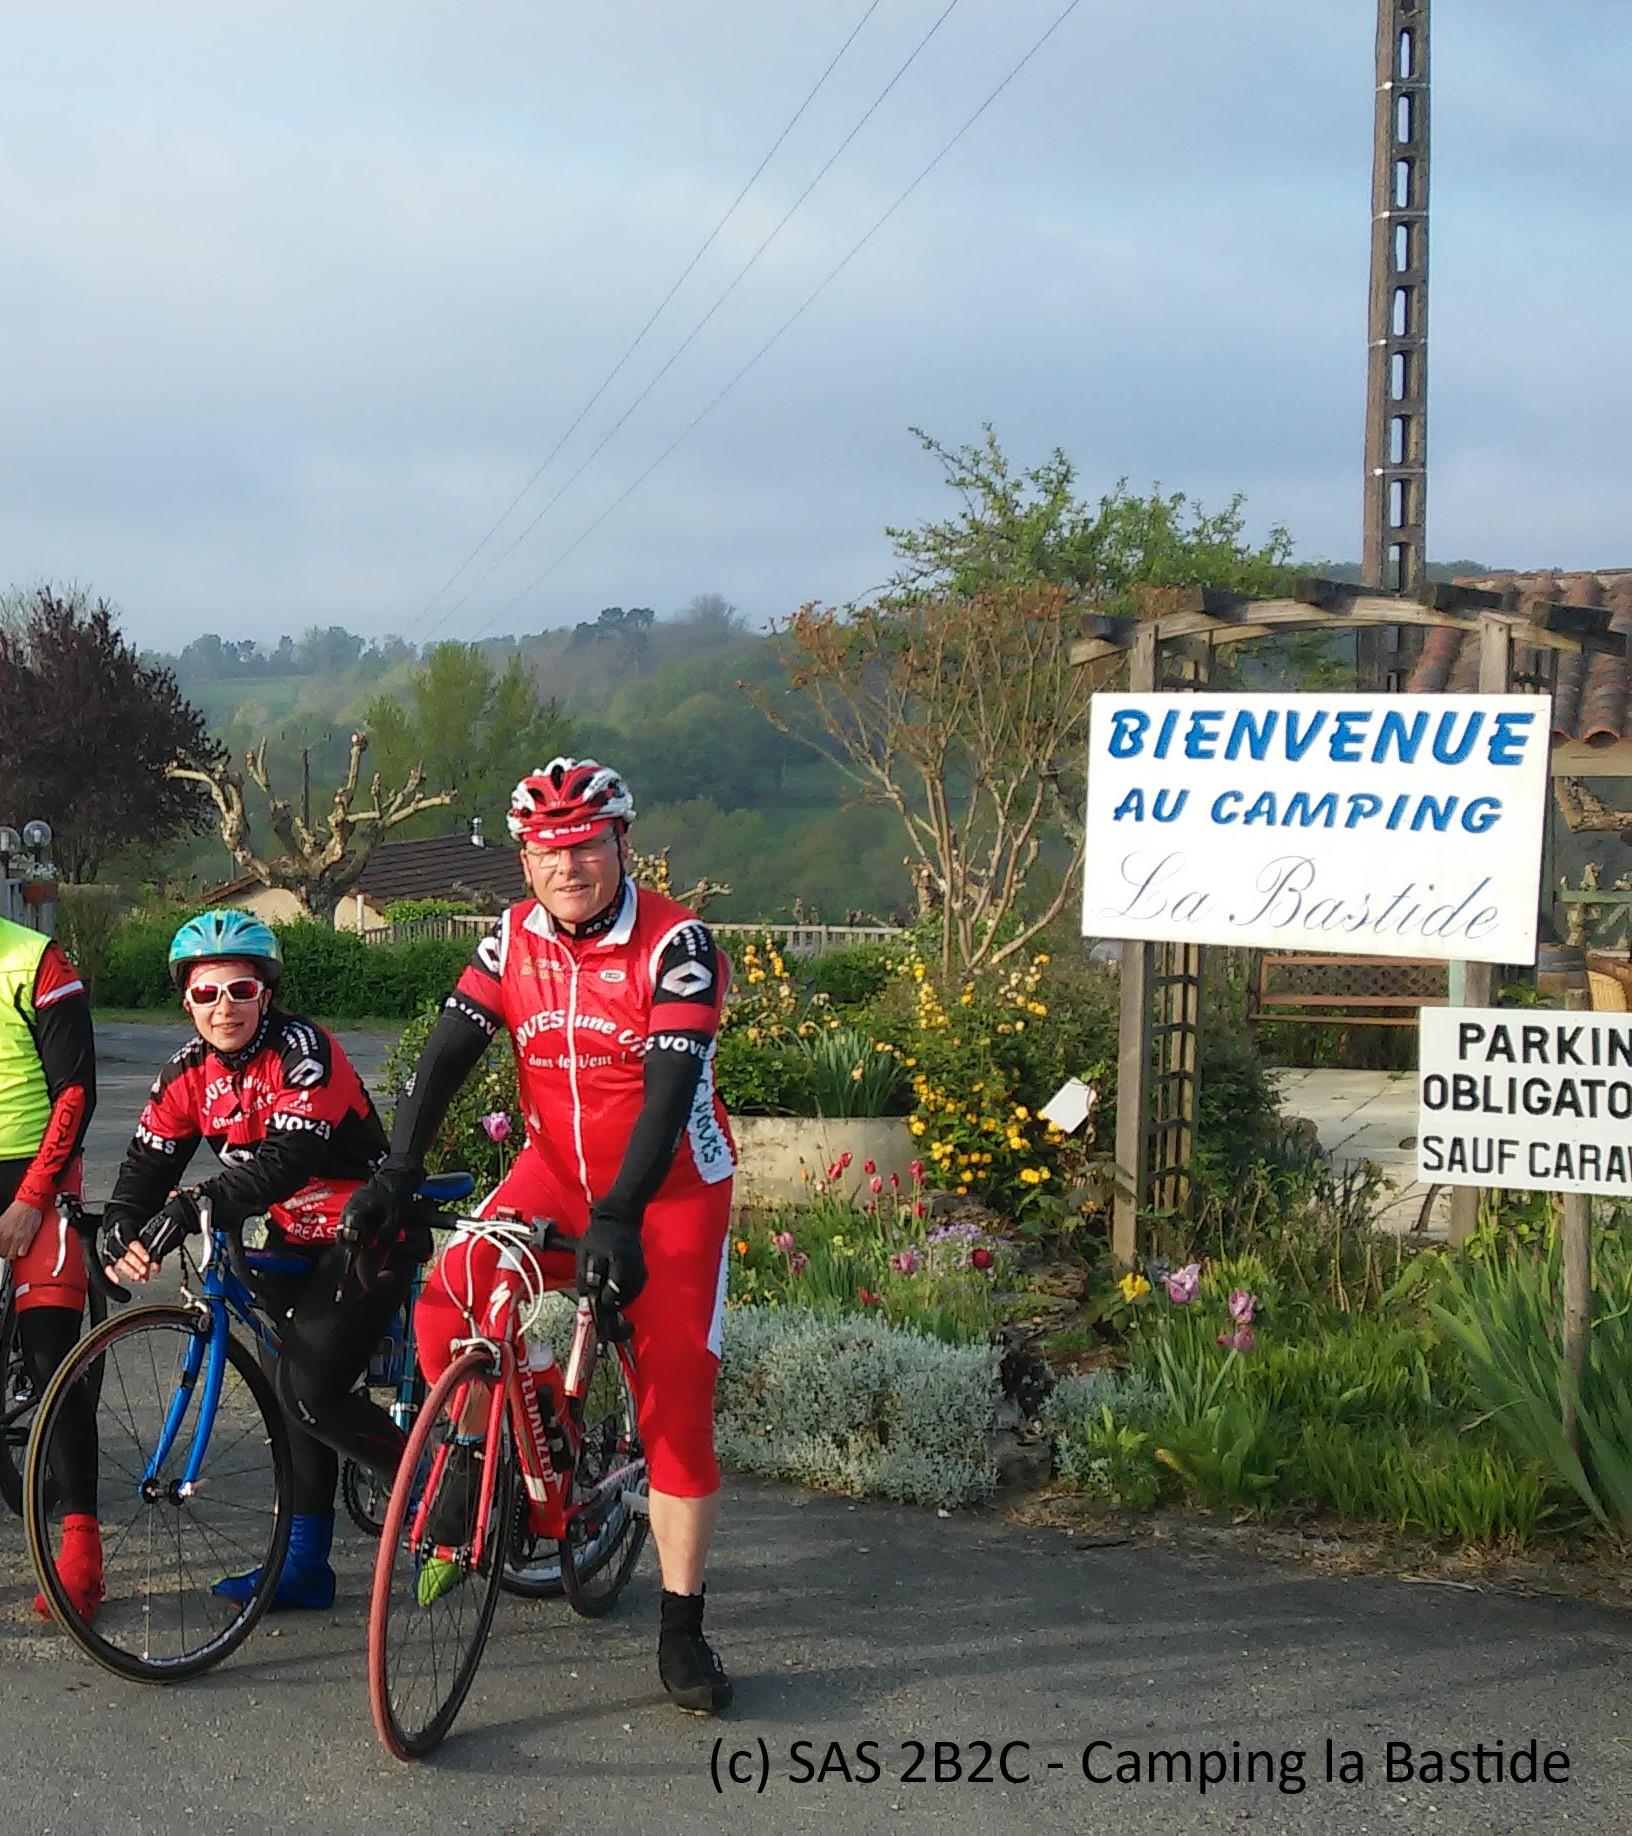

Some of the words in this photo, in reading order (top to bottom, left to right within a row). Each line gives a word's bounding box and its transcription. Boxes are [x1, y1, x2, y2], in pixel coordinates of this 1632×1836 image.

[1108, 708, 1535, 767] BIENVENUE
[1113, 787, 1190, 823] AU
[1210, 790, 1504, 834] CAMPING
[1101, 851, 1211, 922] La
[1229, 854, 1503, 941] Bastide
[573, 1013, 618, 1036] une
[1458, 1022, 1632, 1067] PARKIN
[528, 1053, 554, 1068] dans
[577, 1052, 614, 1070] Vent
[1423, 1073, 1632, 1119] OBLIGATO
[1422, 1135, 1520, 1175] SAUF
[1528, 1141, 1632, 1183] CARA
[286, 1221, 338, 1241] AREAS
[517, 1354, 555, 1484] SPECIALIZED
